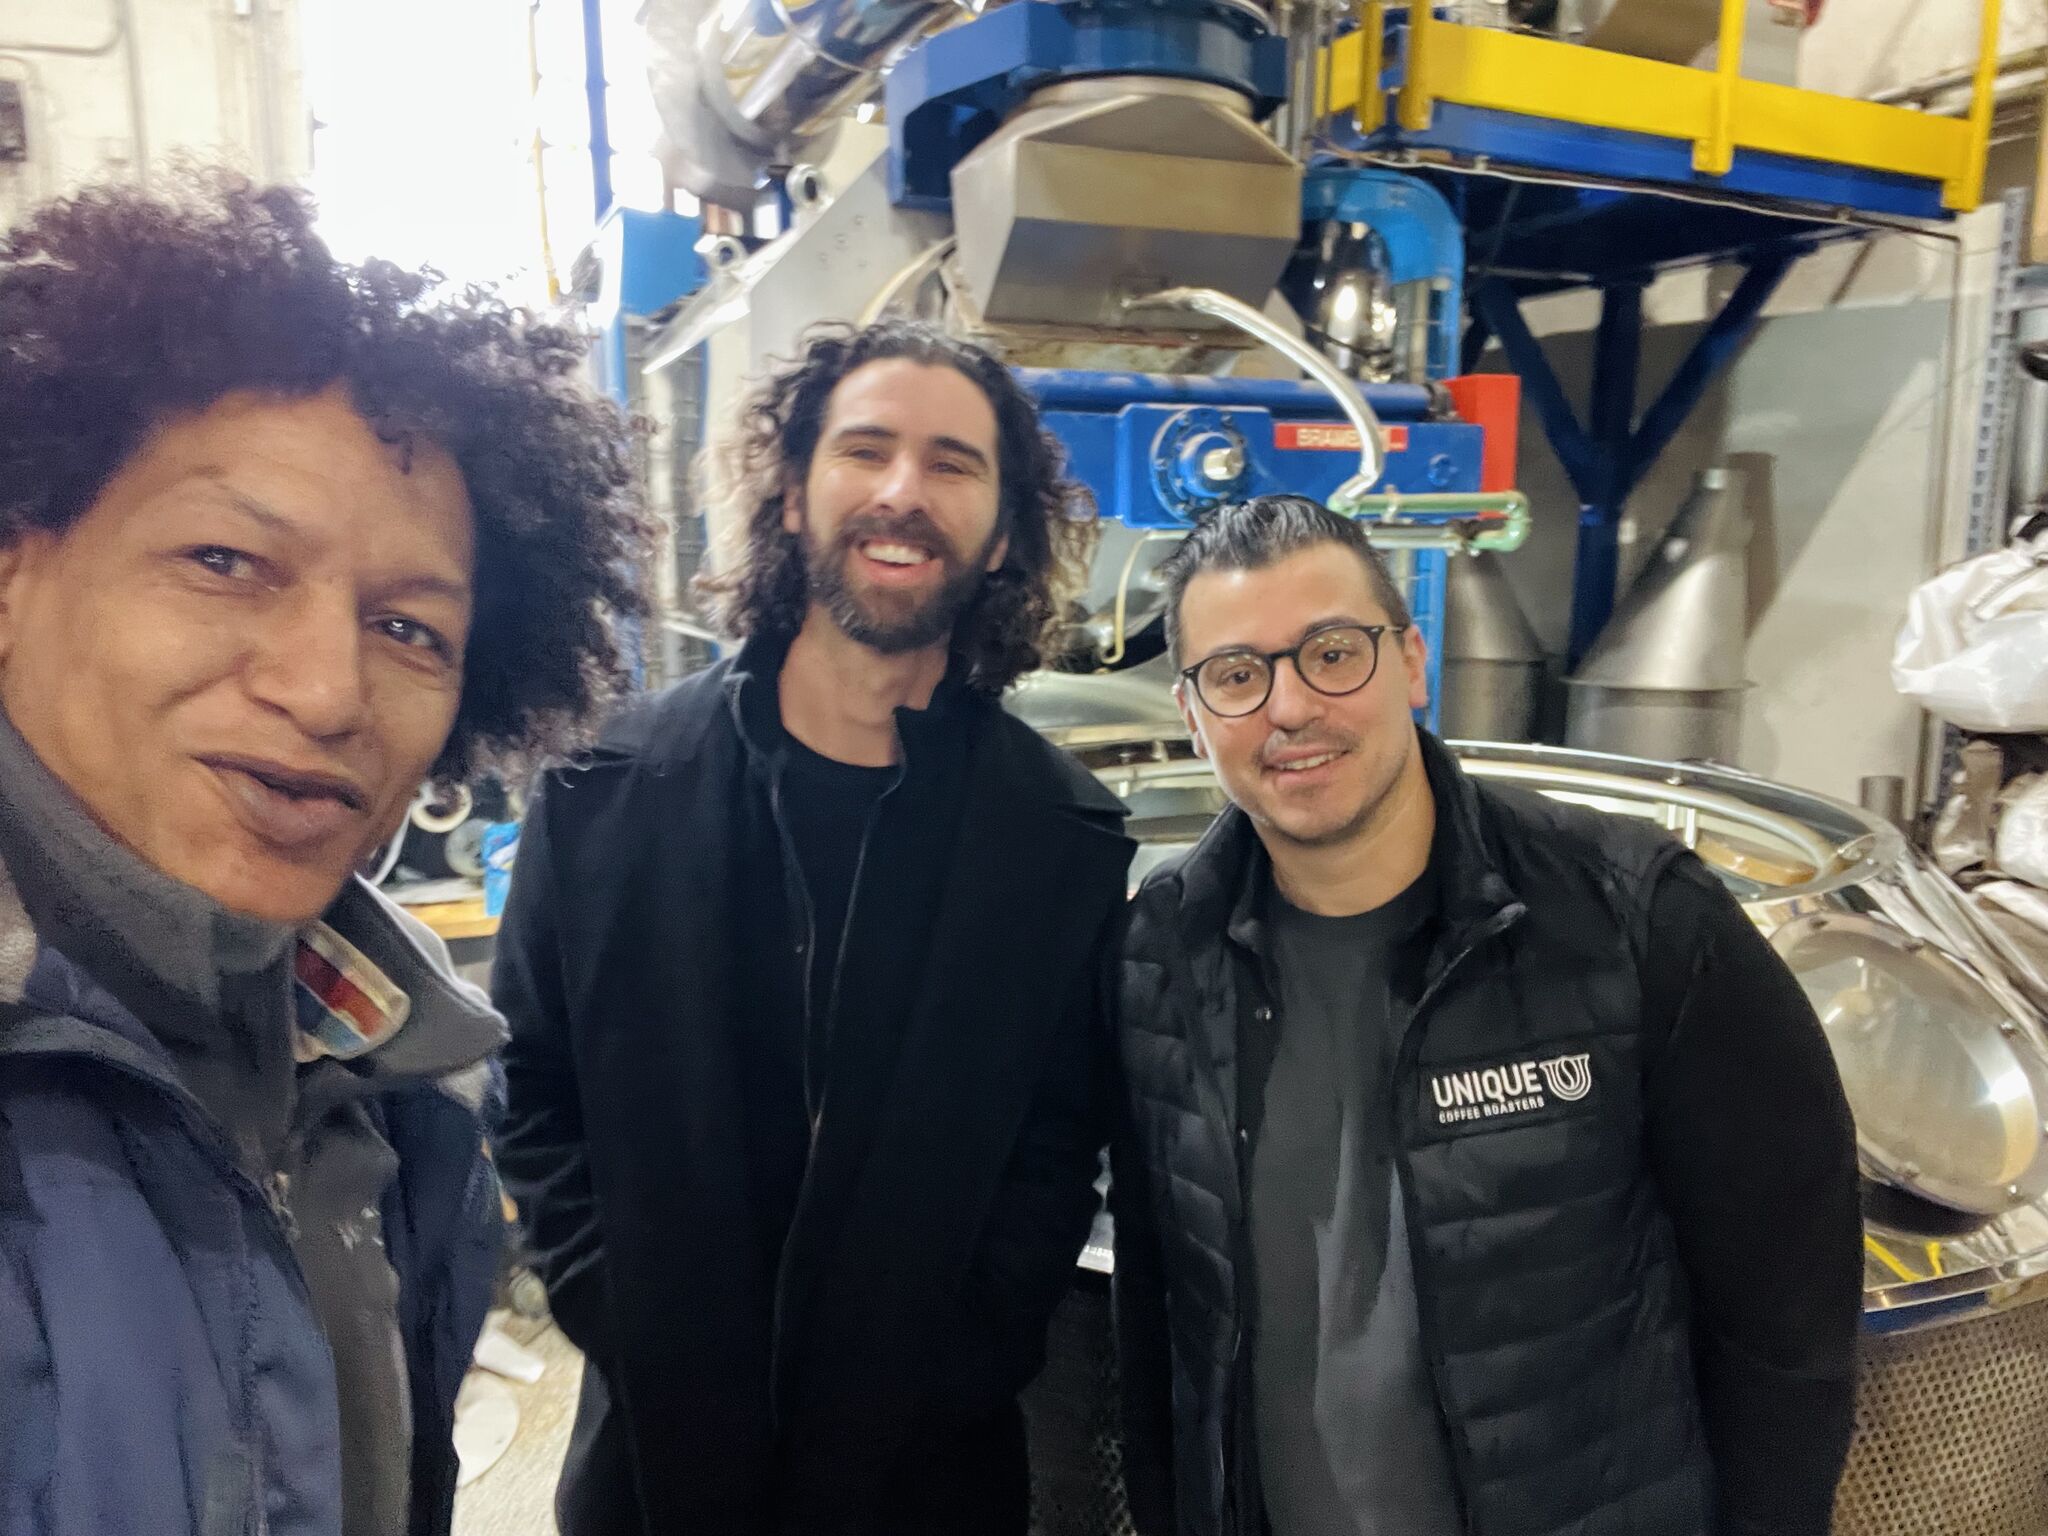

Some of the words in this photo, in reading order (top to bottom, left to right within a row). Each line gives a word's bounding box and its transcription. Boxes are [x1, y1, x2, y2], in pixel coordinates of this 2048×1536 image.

[1432, 1061, 1543, 1107] UNIQUE
[1438, 1105, 1481, 1124] COFFEE
[1484, 1095, 1545, 1117] ROASTERS
